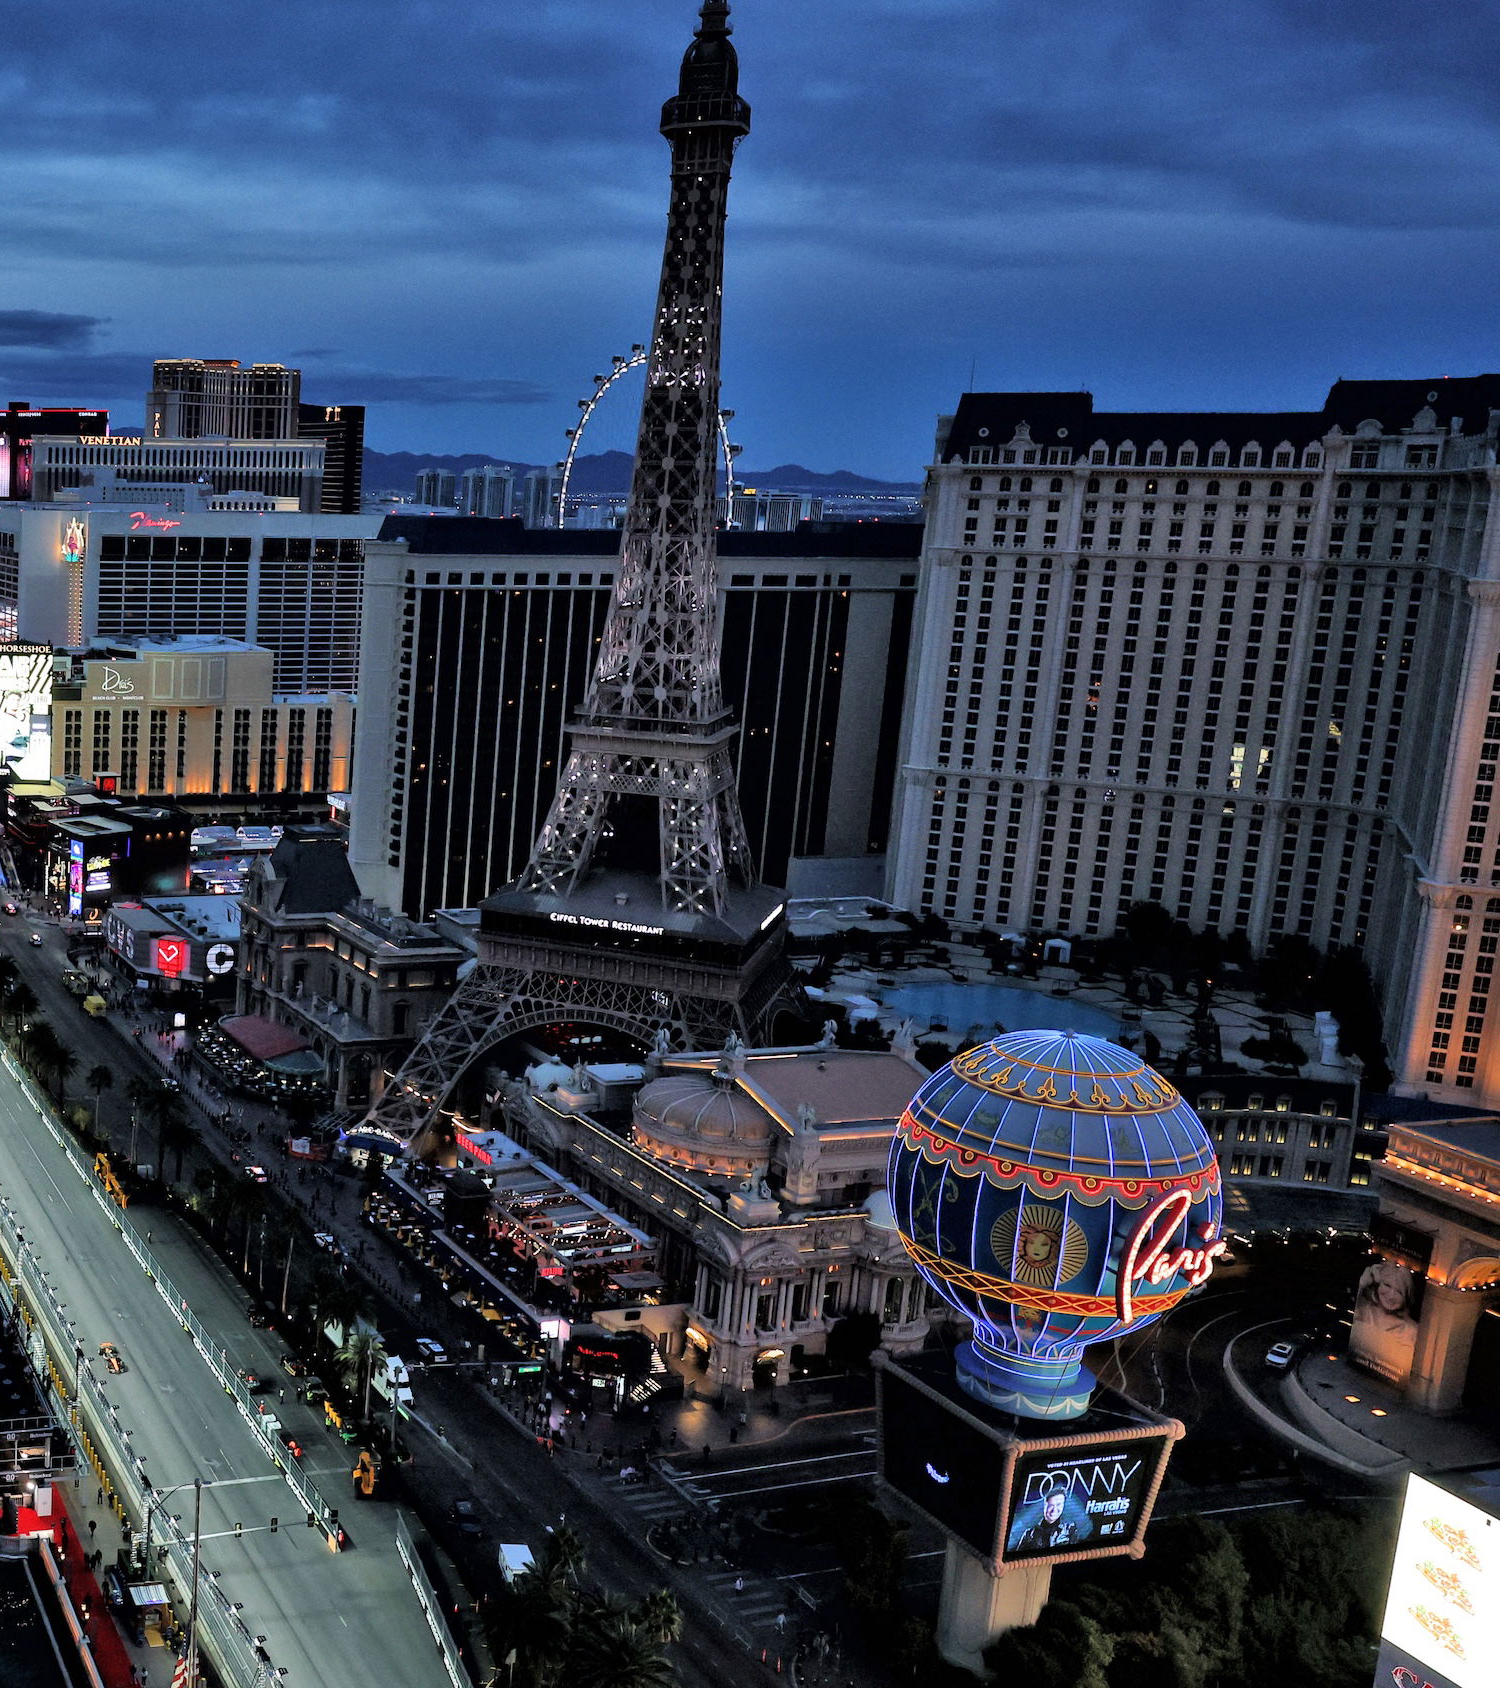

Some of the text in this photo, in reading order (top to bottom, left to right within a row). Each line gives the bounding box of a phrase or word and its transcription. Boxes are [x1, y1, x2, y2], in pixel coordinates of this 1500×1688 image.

[79, 435, 142, 447] VENETIAN
[0, 644, 52, 654] HORSESHOE
[550, 912, 664, 936] EIFFEL TOWER RESTAURANT
[456, 1133, 475, 1155] BEER
[1120, 1188, 1227, 1325] Paris
[1023, 1460, 1142, 1505] DONNY
